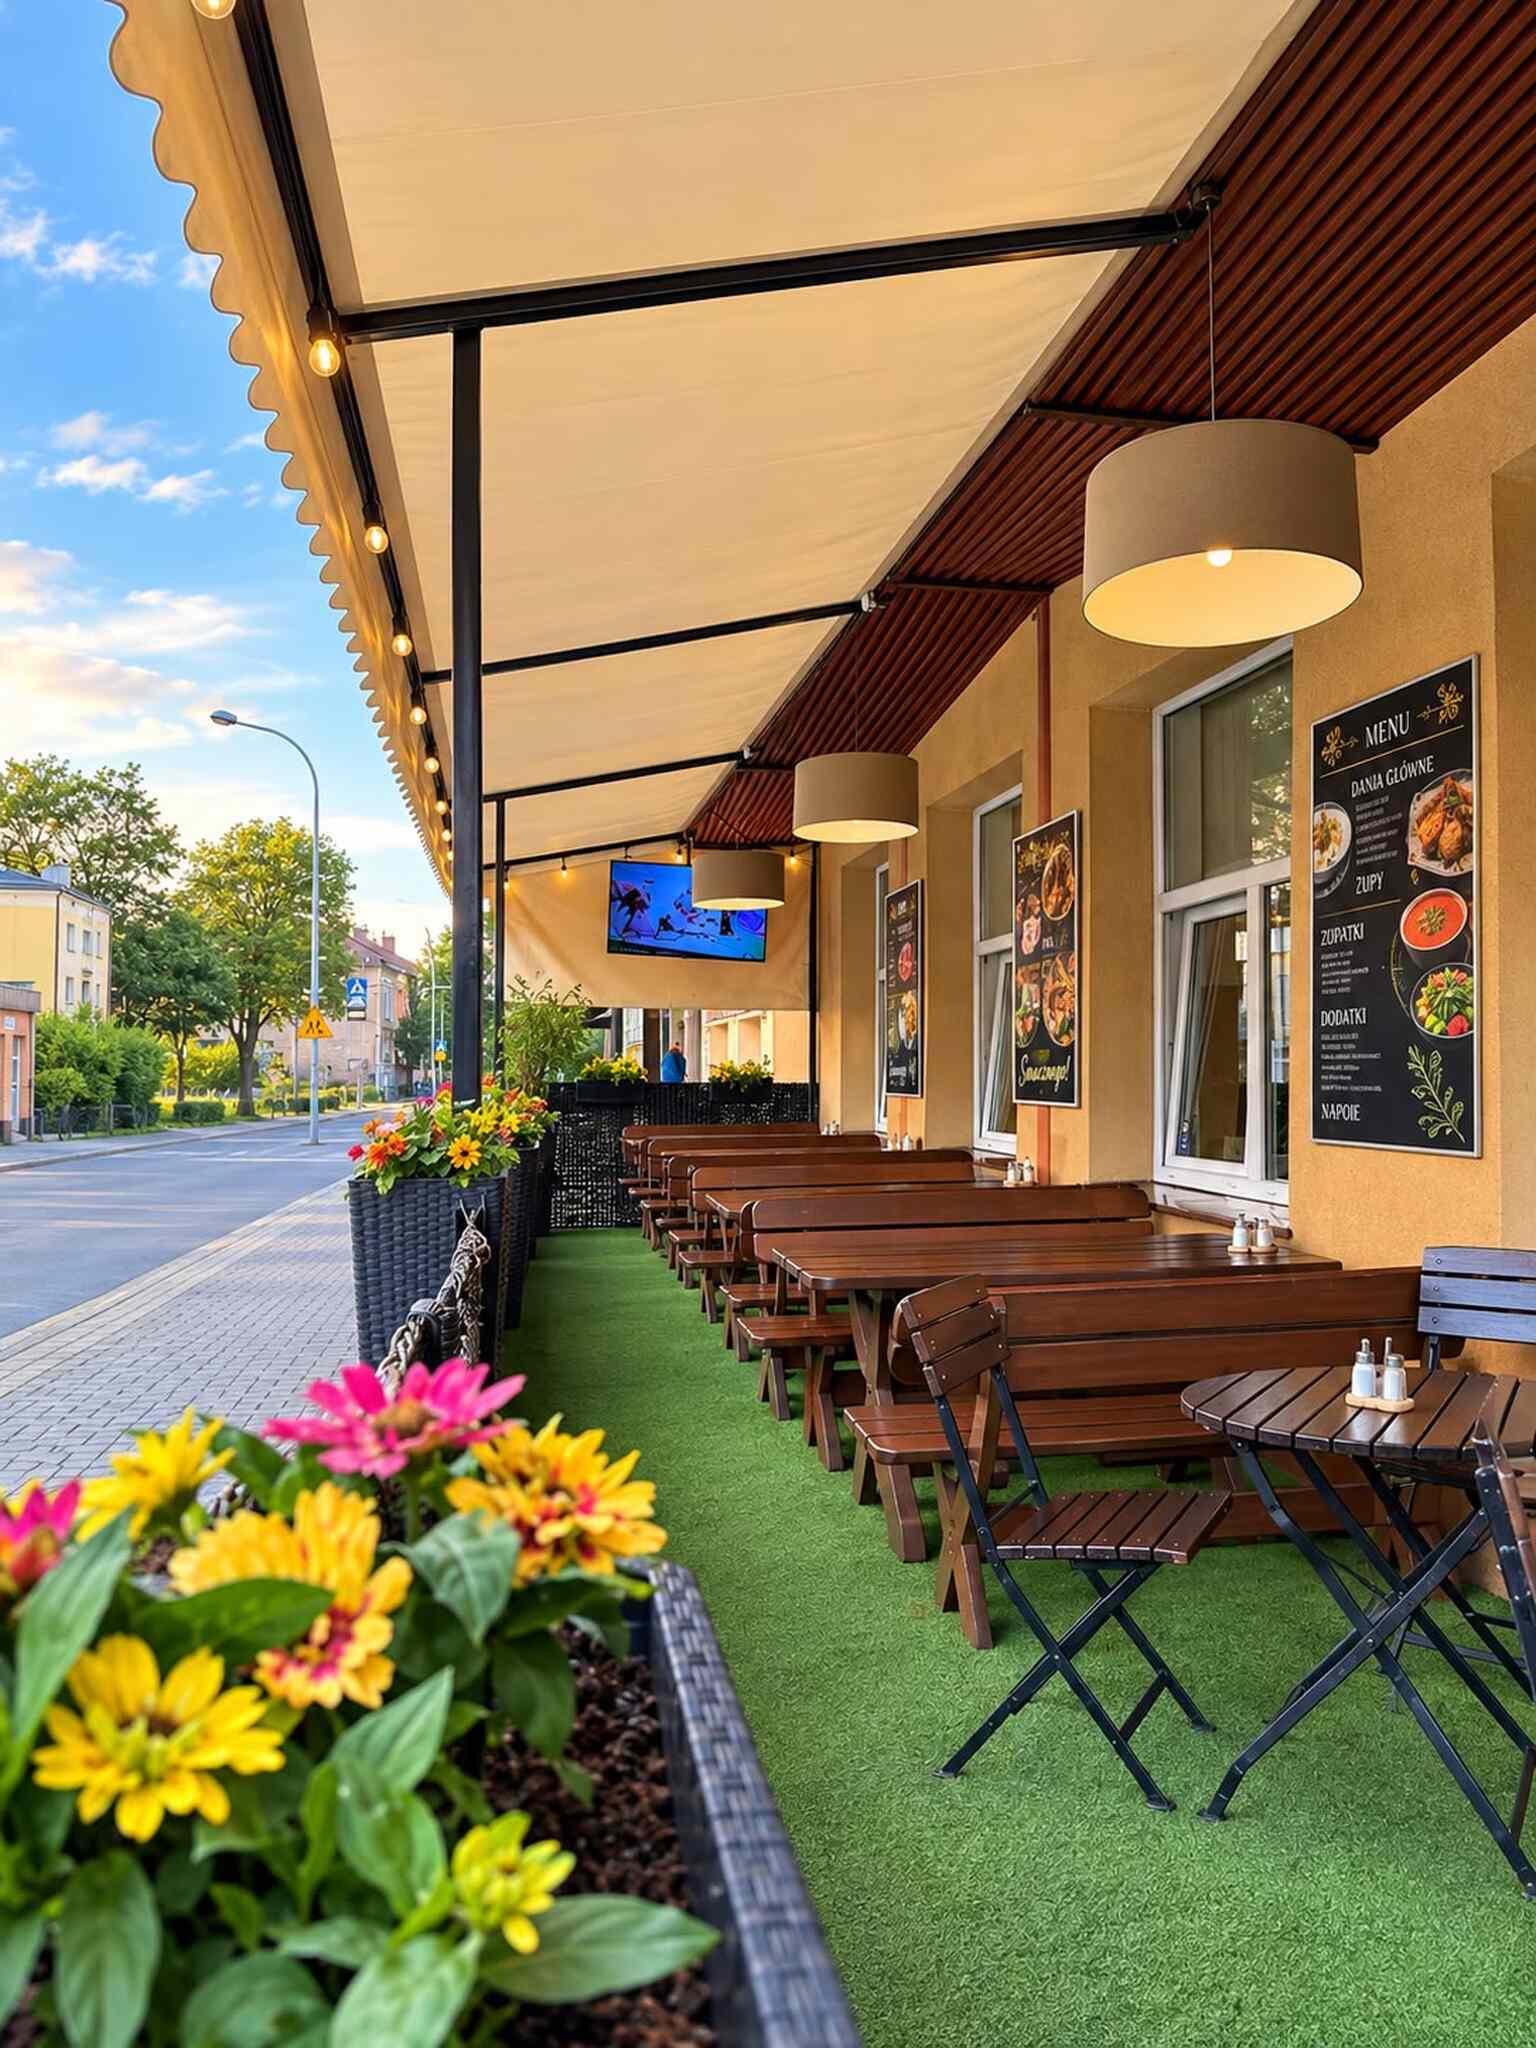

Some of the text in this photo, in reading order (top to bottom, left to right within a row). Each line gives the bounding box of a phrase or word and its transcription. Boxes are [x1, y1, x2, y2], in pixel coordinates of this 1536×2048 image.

[1365, 711, 1410, 748] MENU
[1351, 773, 1384, 798] DANIA
[1356, 871, 1384, 895] ZUPY
[1320, 922, 1364, 946] ZUPATKI
[1321, 1008, 1367, 1027] DODATKI
[1321, 1103, 1361, 1121] NAPOIE
